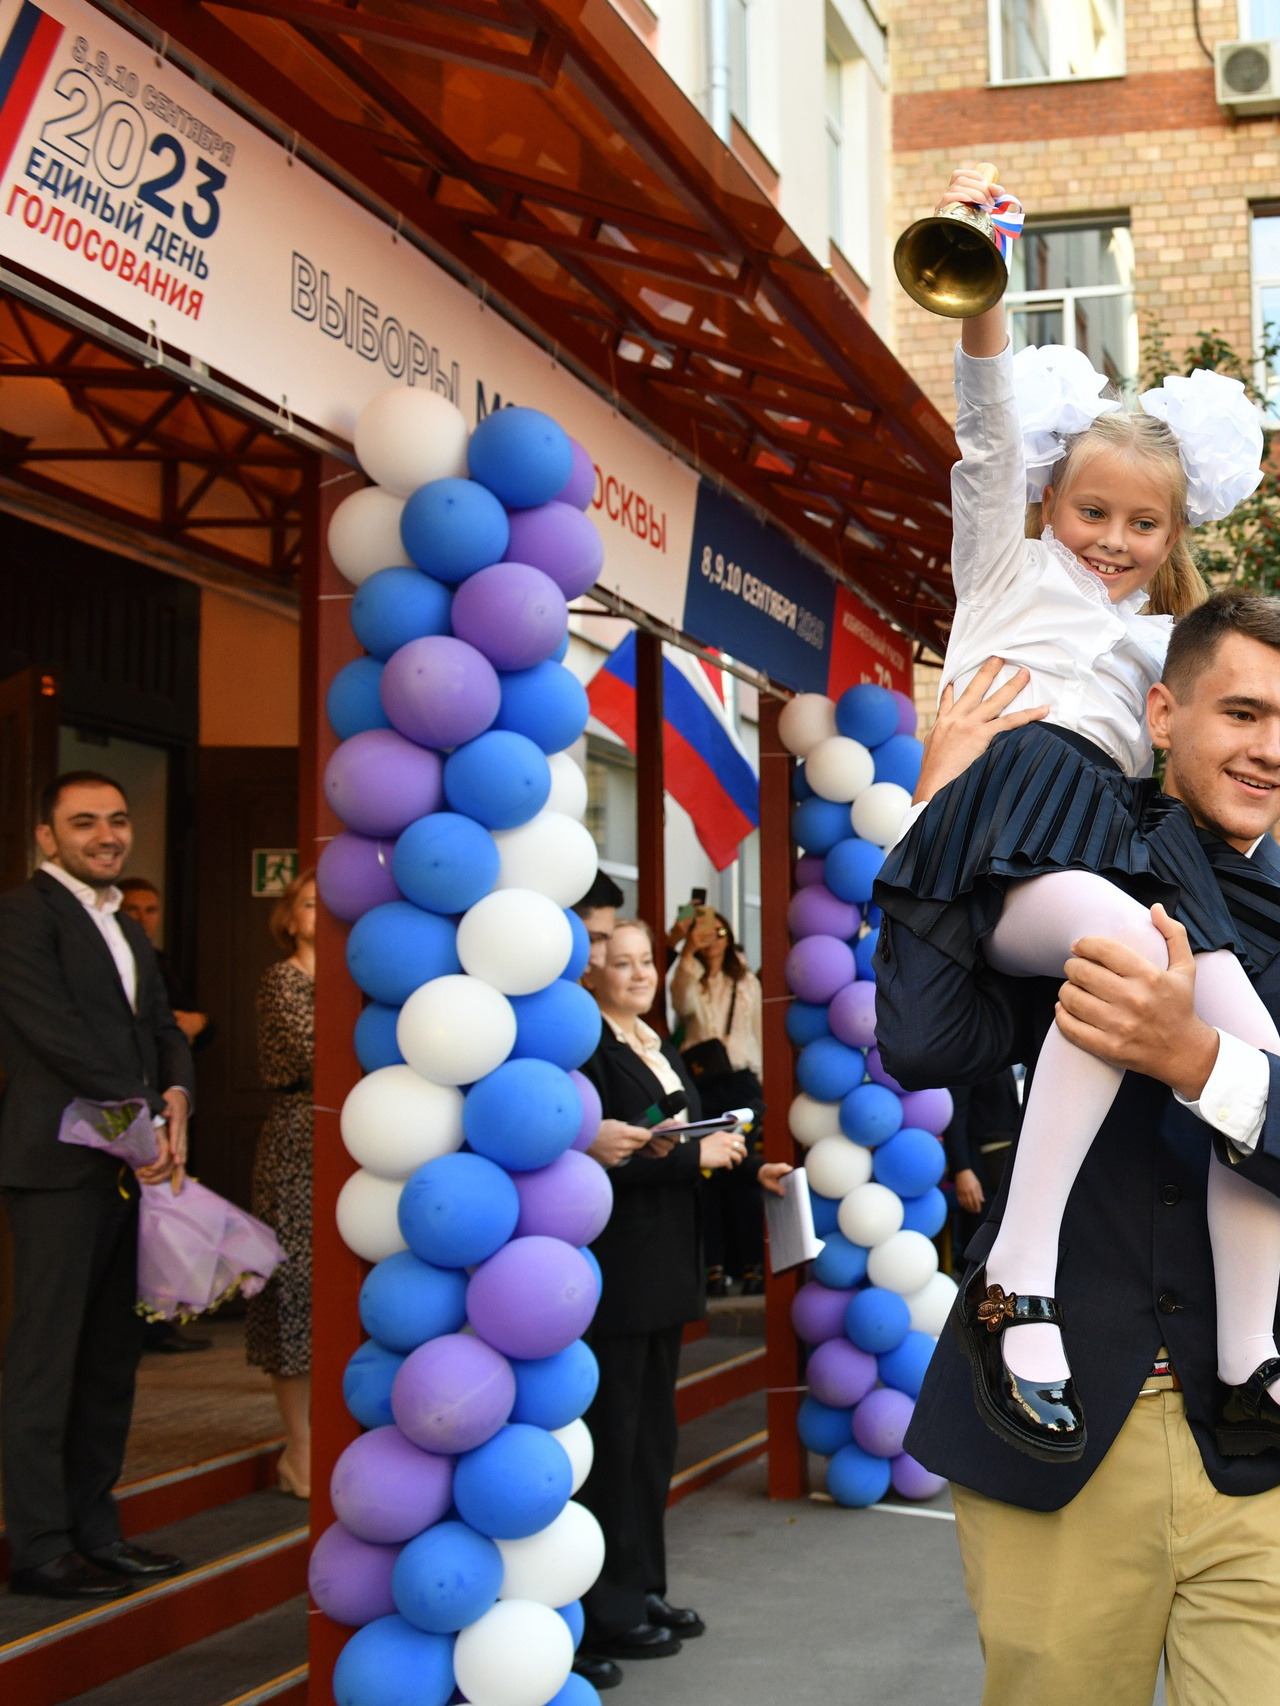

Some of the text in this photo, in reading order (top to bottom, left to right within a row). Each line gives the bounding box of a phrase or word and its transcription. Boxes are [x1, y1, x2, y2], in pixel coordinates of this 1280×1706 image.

[40, 68, 228, 239] 2023
[141, 84, 236, 167] СЕНТЯБРЯ
[5, 184, 204, 321] ГОЛОСОВАНИЯ
[24, 146, 209, 280] ЕДИНЫЙ ДЕНЬ
[291, 250, 666, 554] ВЫБОРЫ ОСКВЫ
[742, 571, 798, 631] СЕНТЯБРЯ
